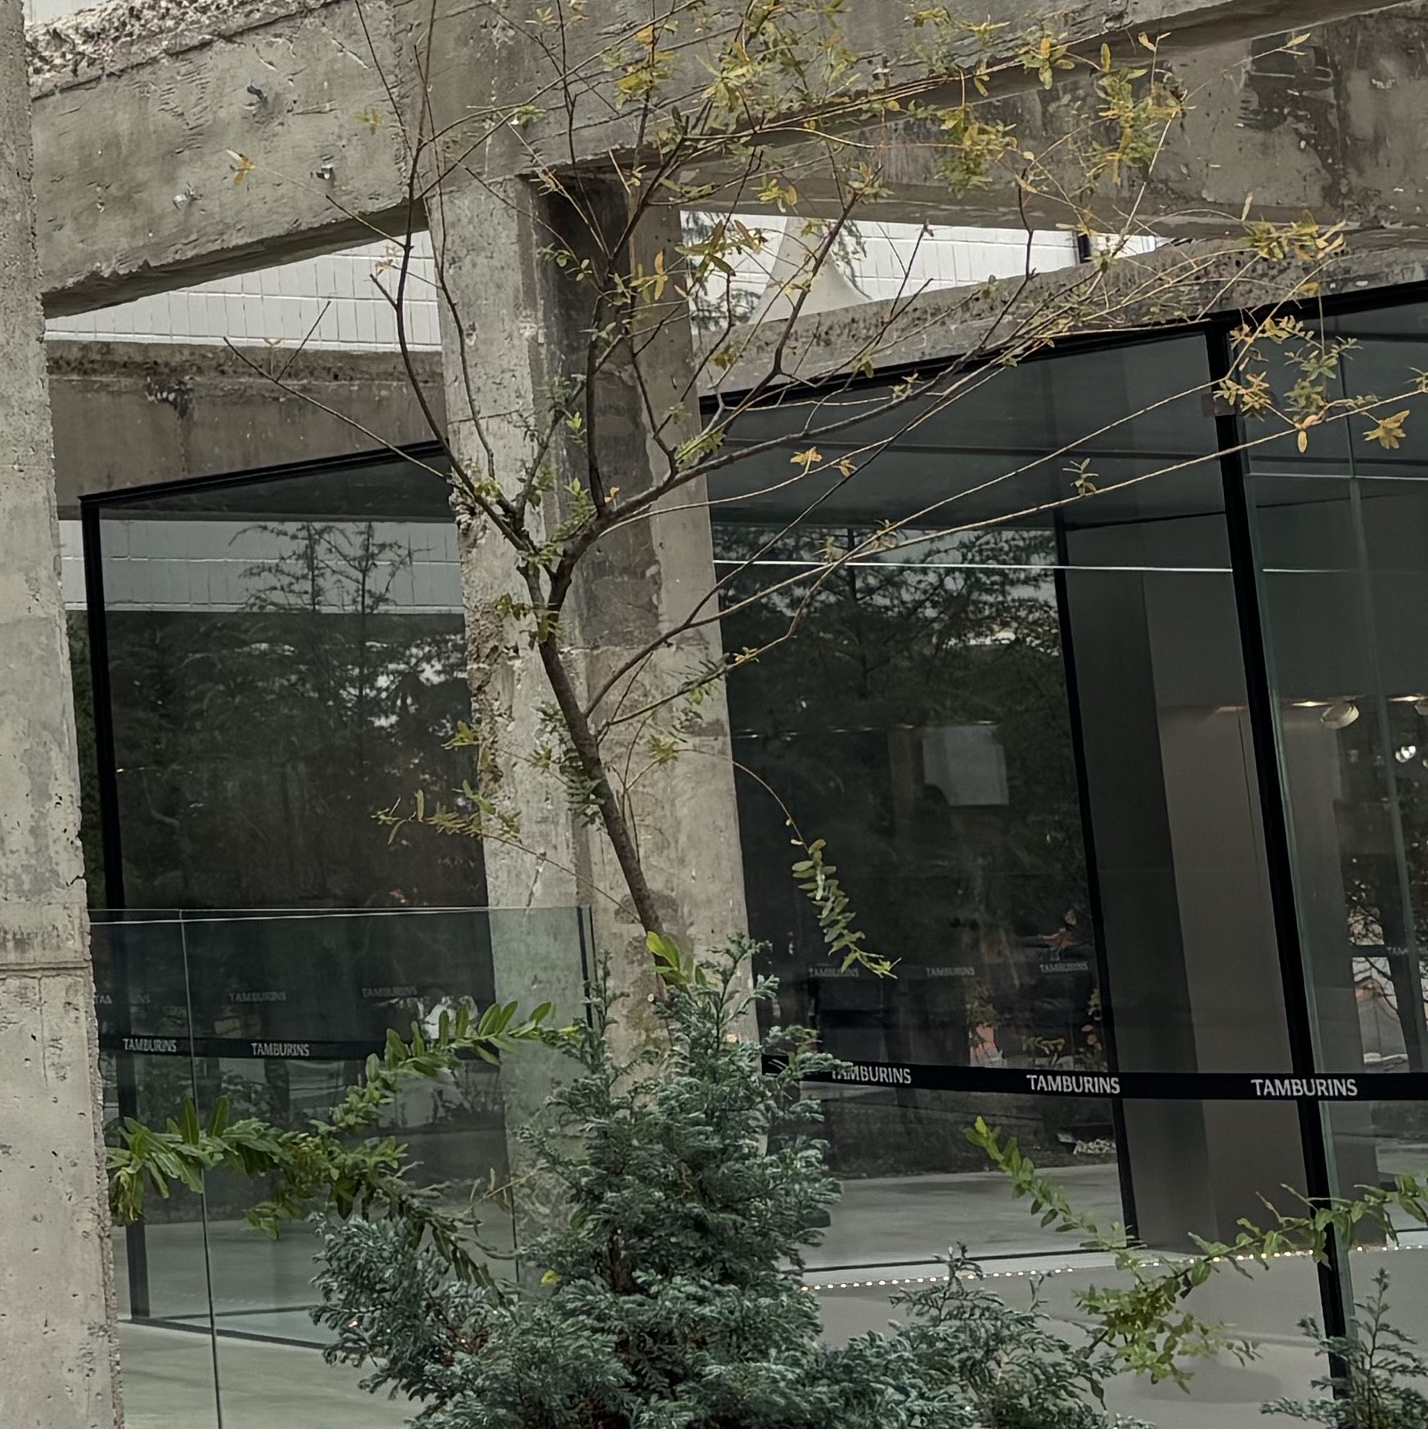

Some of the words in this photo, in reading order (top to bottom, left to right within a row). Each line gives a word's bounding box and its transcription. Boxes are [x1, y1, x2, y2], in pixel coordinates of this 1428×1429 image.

[122, 1037, 178, 1054] TAMBURINS
[250, 1041, 310, 1058] TAMBURINS
[1025, 1073, 1121, 1095] TAMBURINS
[1249, 1078, 1359, 1097] TAMBURINS
